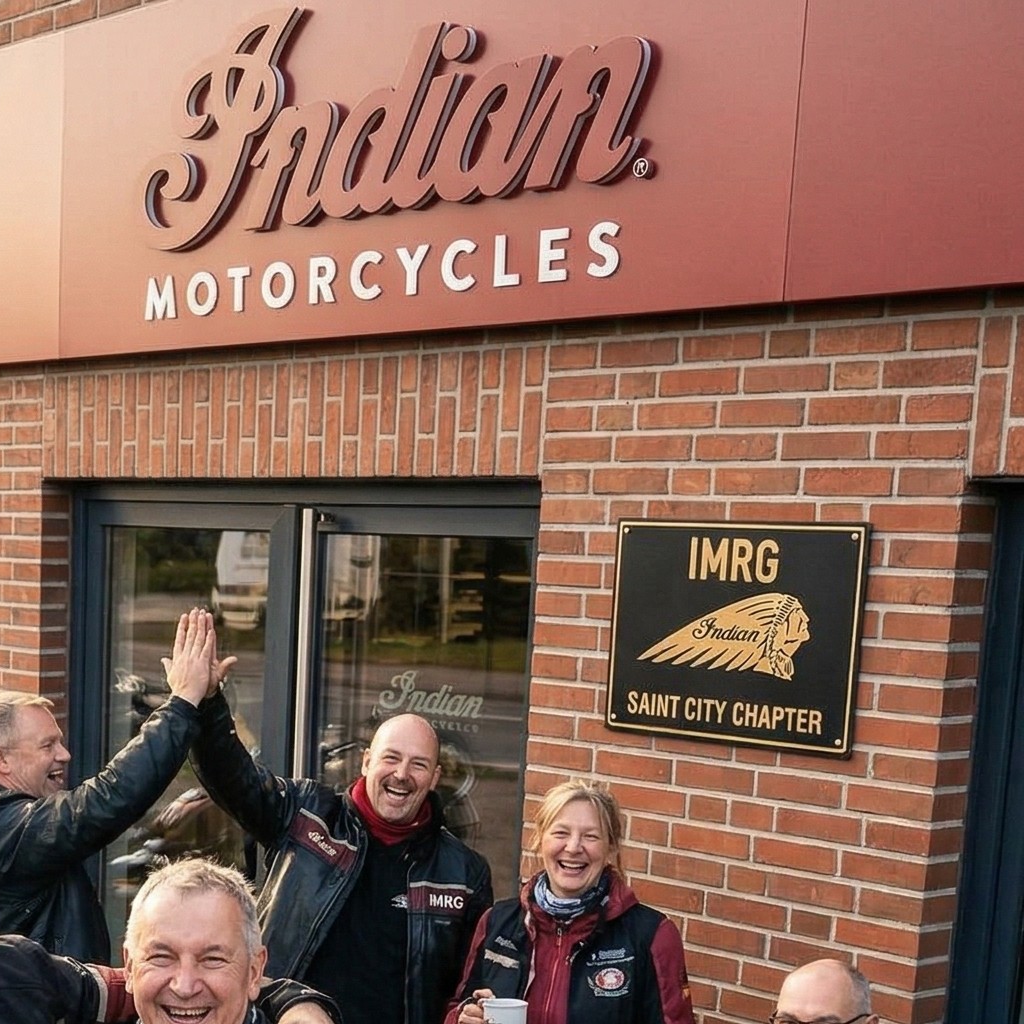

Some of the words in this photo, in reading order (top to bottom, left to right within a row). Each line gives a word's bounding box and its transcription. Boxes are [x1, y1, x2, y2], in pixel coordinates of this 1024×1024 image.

[143, 5, 651, 252] Indian
[144, 221, 621, 321] MOTORCYCLES
[688, 536, 780, 584] IMRG
[692, 617, 760, 642] Indian
[379, 670, 483, 718] Indian
[627, 691, 679, 720] SAINT
[684, 697, 728, 725] CITY
[732, 701, 822, 736] CHAPTER
